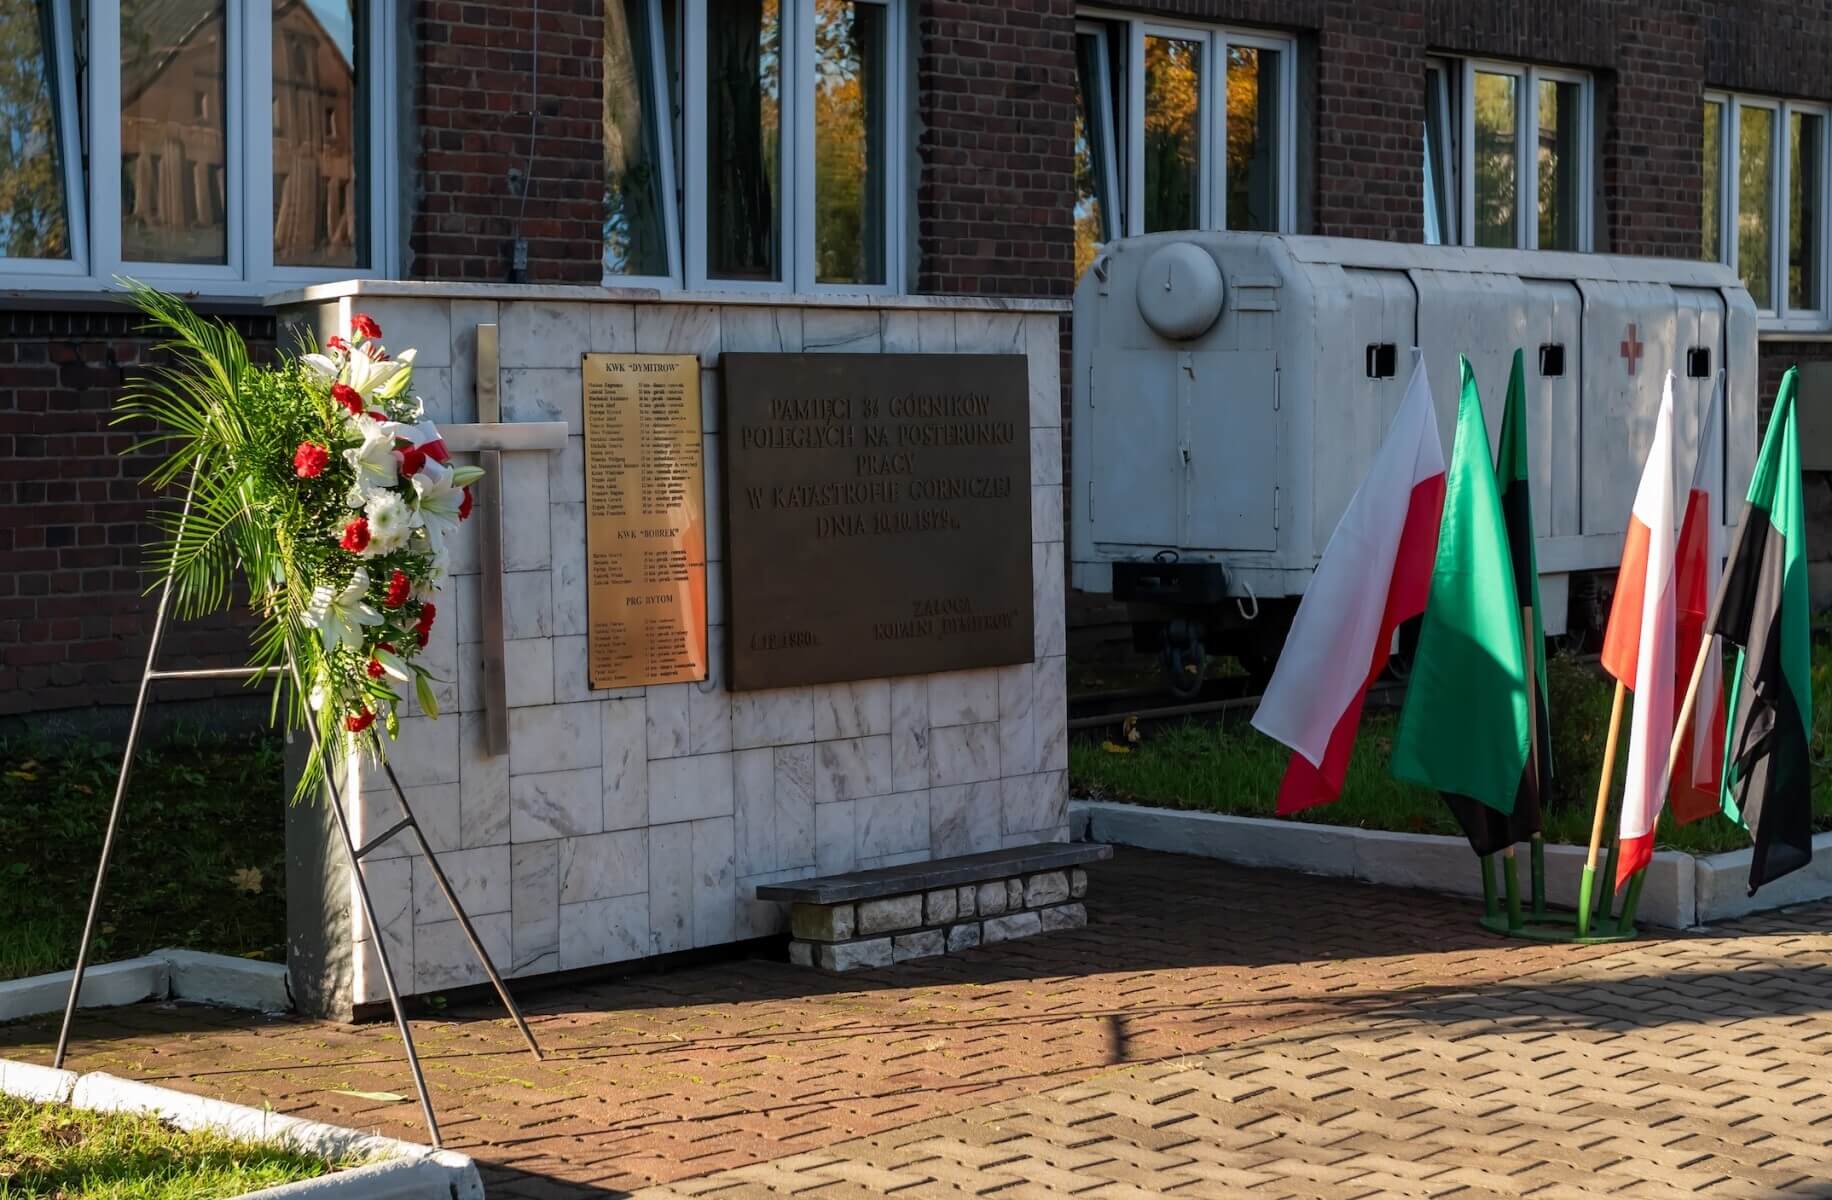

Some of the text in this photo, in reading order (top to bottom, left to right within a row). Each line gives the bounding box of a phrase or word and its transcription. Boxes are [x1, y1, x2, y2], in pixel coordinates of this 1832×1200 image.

[606, 362, 625, 373] KWK
[864, 424, 889, 448] NA
[900, 422, 1015, 447] POSTERUNKU
[856, 453, 915, 478] PRACY
[746, 486, 764, 511] W
[773, 479, 900, 510] KATASTROFIE
[816, 515, 865, 539] DNIA
